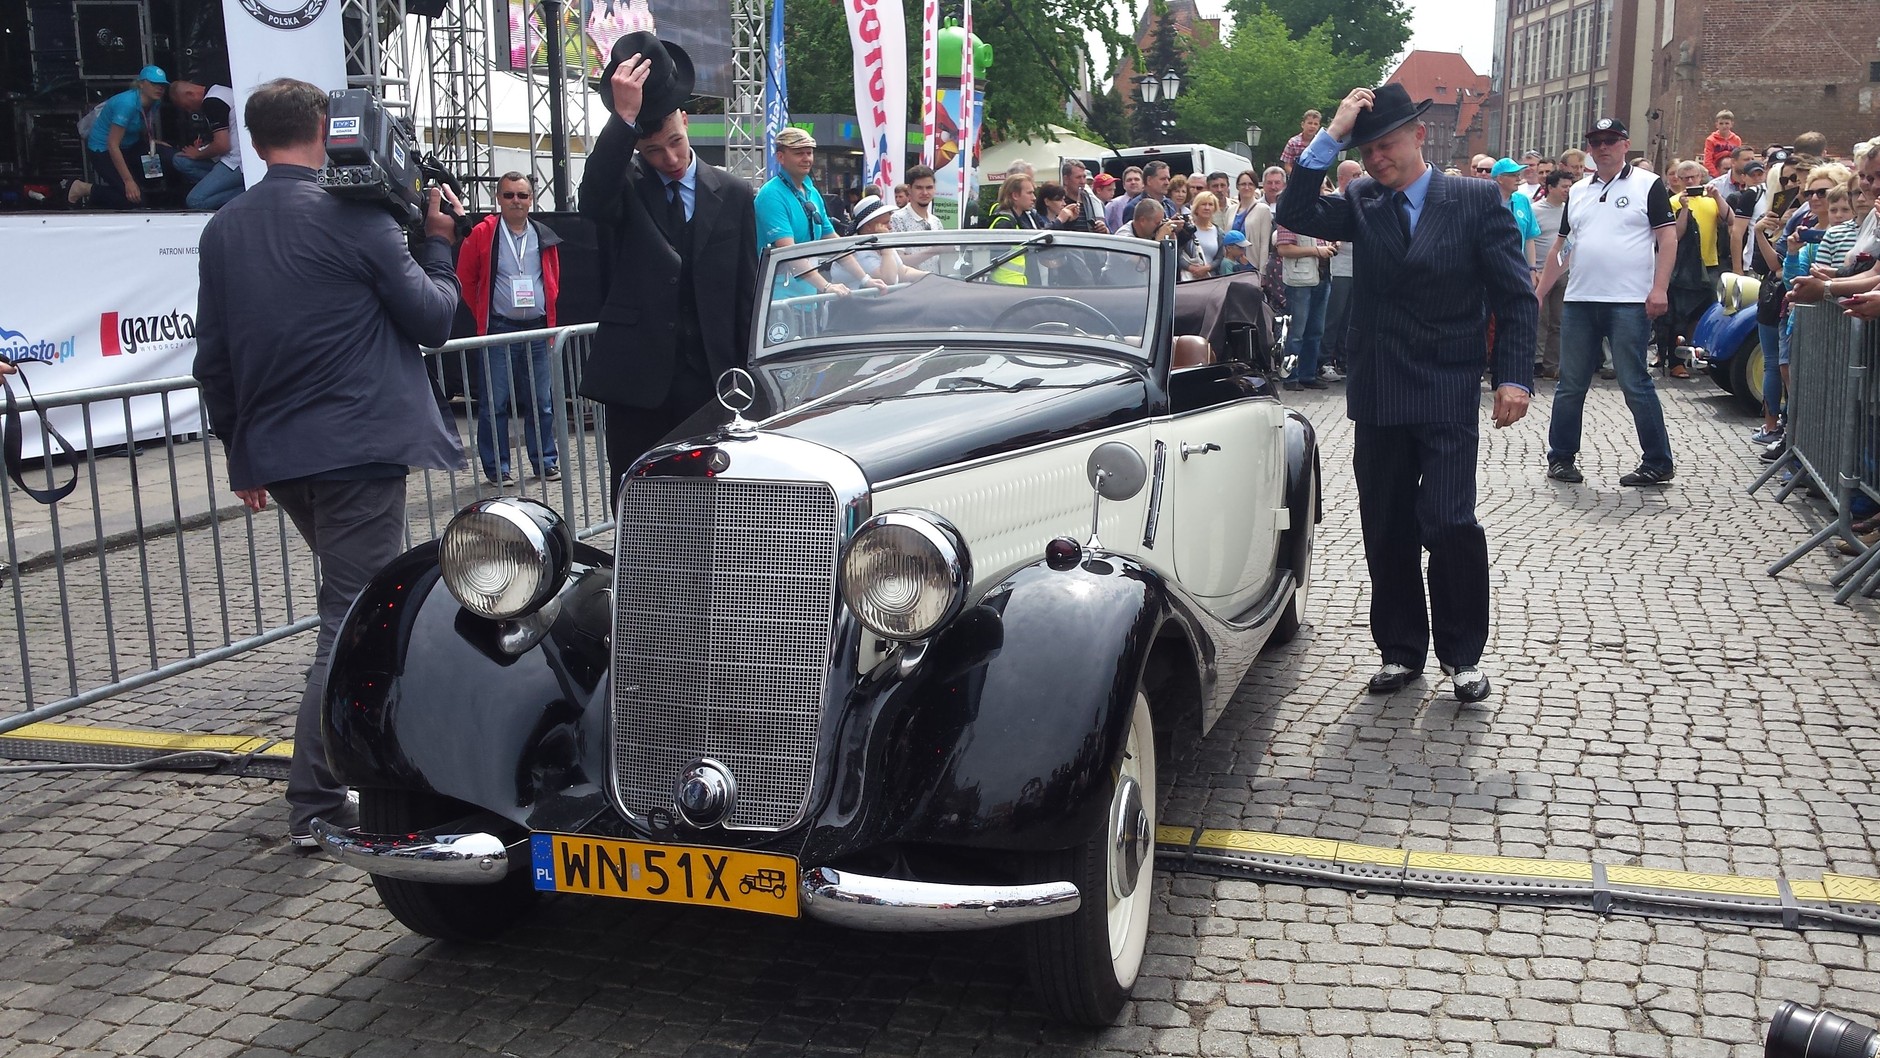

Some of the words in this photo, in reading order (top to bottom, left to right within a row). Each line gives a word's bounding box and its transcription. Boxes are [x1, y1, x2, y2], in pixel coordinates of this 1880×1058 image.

[268, 14, 300, 26] POLSKA
[159, 247, 185, 256] PATRONI
[185, 246, 200, 255] MED
[121, 307, 196, 354] gazeta
[140, 342, 184, 352] WYBORCZA
[536, 868, 552, 881] PL
[561, 841, 628, 892] WN
[643, 849, 731, 902] 51X
